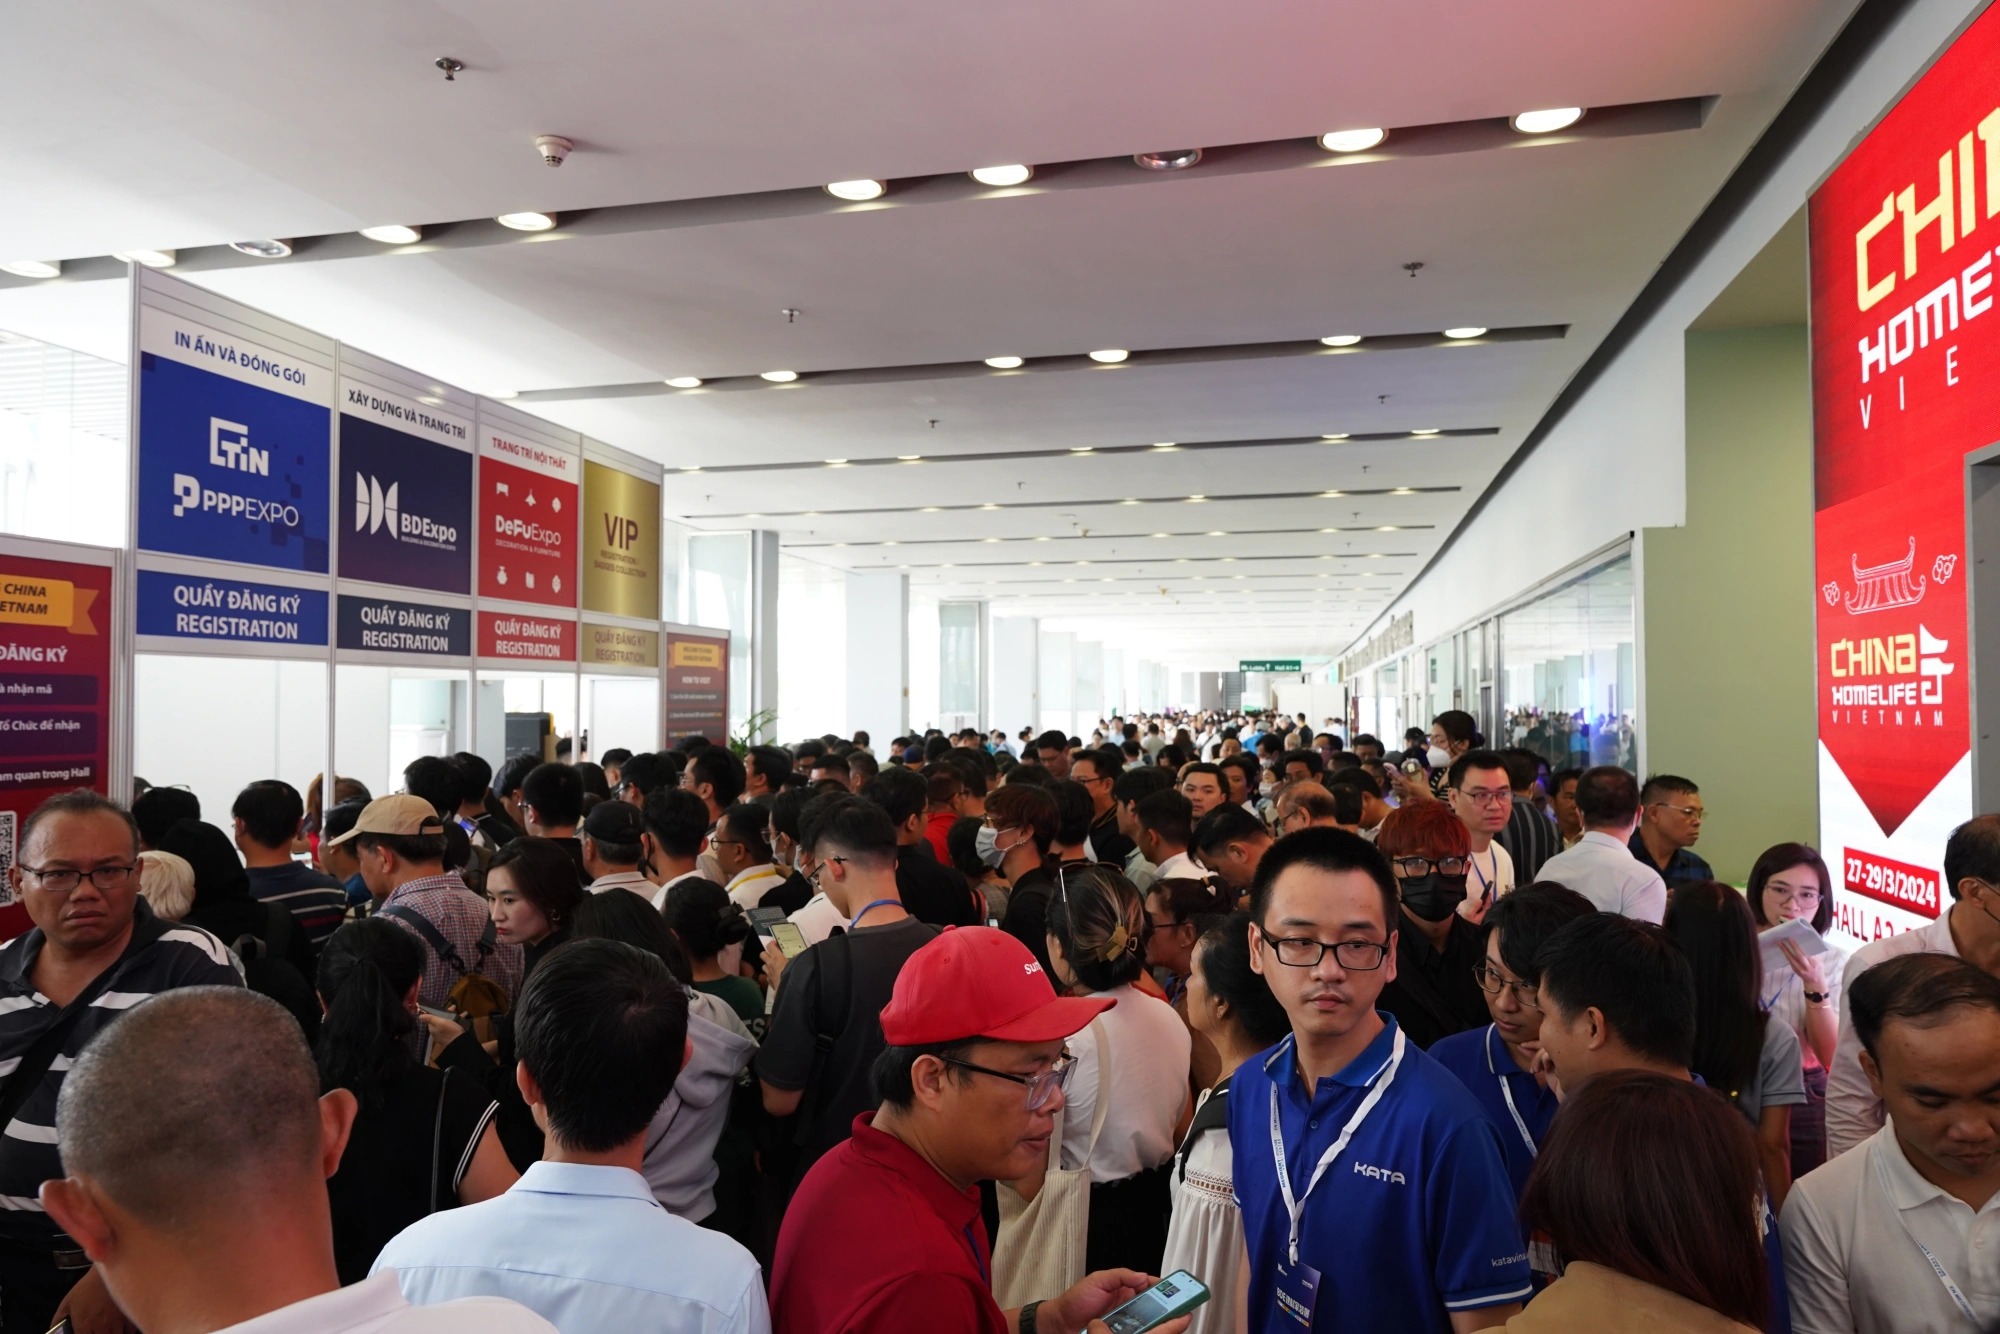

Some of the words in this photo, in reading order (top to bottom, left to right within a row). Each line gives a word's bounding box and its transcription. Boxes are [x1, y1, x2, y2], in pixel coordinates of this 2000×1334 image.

[1858, 245, 2000, 384] HOME
[175, 331, 190, 349] IN
[218, 345, 237, 364] VÀ
[240, 353, 280, 378] ĐÓNG
[283, 367, 306, 386] GÓI
[349, 389, 369, 407] XÂY
[403, 408, 417, 424] VÀ
[418, 413, 451, 435] TRANG
[452, 425, 466, 440] TRÍ
[492, 437, 520, 456] TRANG
[521, 446, 533, 460] TRÍ
[203, 489, 299, 526] PPPEXPO
[401, 512, 457, 543] BDExpo
[495, 514, 561, 547] DeFuExpo
[604, 512, 638, 551] VIP
[4, 583, 47, 597] CHINA
[227, 588, 277, 612] ĐĂNG
[280, 594, 301, 615] KÝ
[176, 613, 298, 640] REGISTRATION
[398, 608, 434, 629] ĐĂNG
[435, 613, 450, 630] KÝ
[522, 621, 549, 638] ĐĂNG
[550, 624, 562, 640] KÝ
[362, 630, 449, 651] REGISTRATION
[496, 640, 560, 658] REGISTRATION
[46, 645, 68, 663] KÝ
[595, 648, 645, 663] REGISTRATION
[1832, 681, 1917, 706] HOMELIFE
[1832, 709, 1943, 726] VIETNAM
[14, 772, 41, 783] quan
[42, 769, 70, 780] trong
[70, 767, 90, 777] Hall
[1847, 857, 1936, 908] 27-29/3/2024
[1833, 901, 1868, 942] HALL
[1354, 1161, 1406, 1185] KATA
